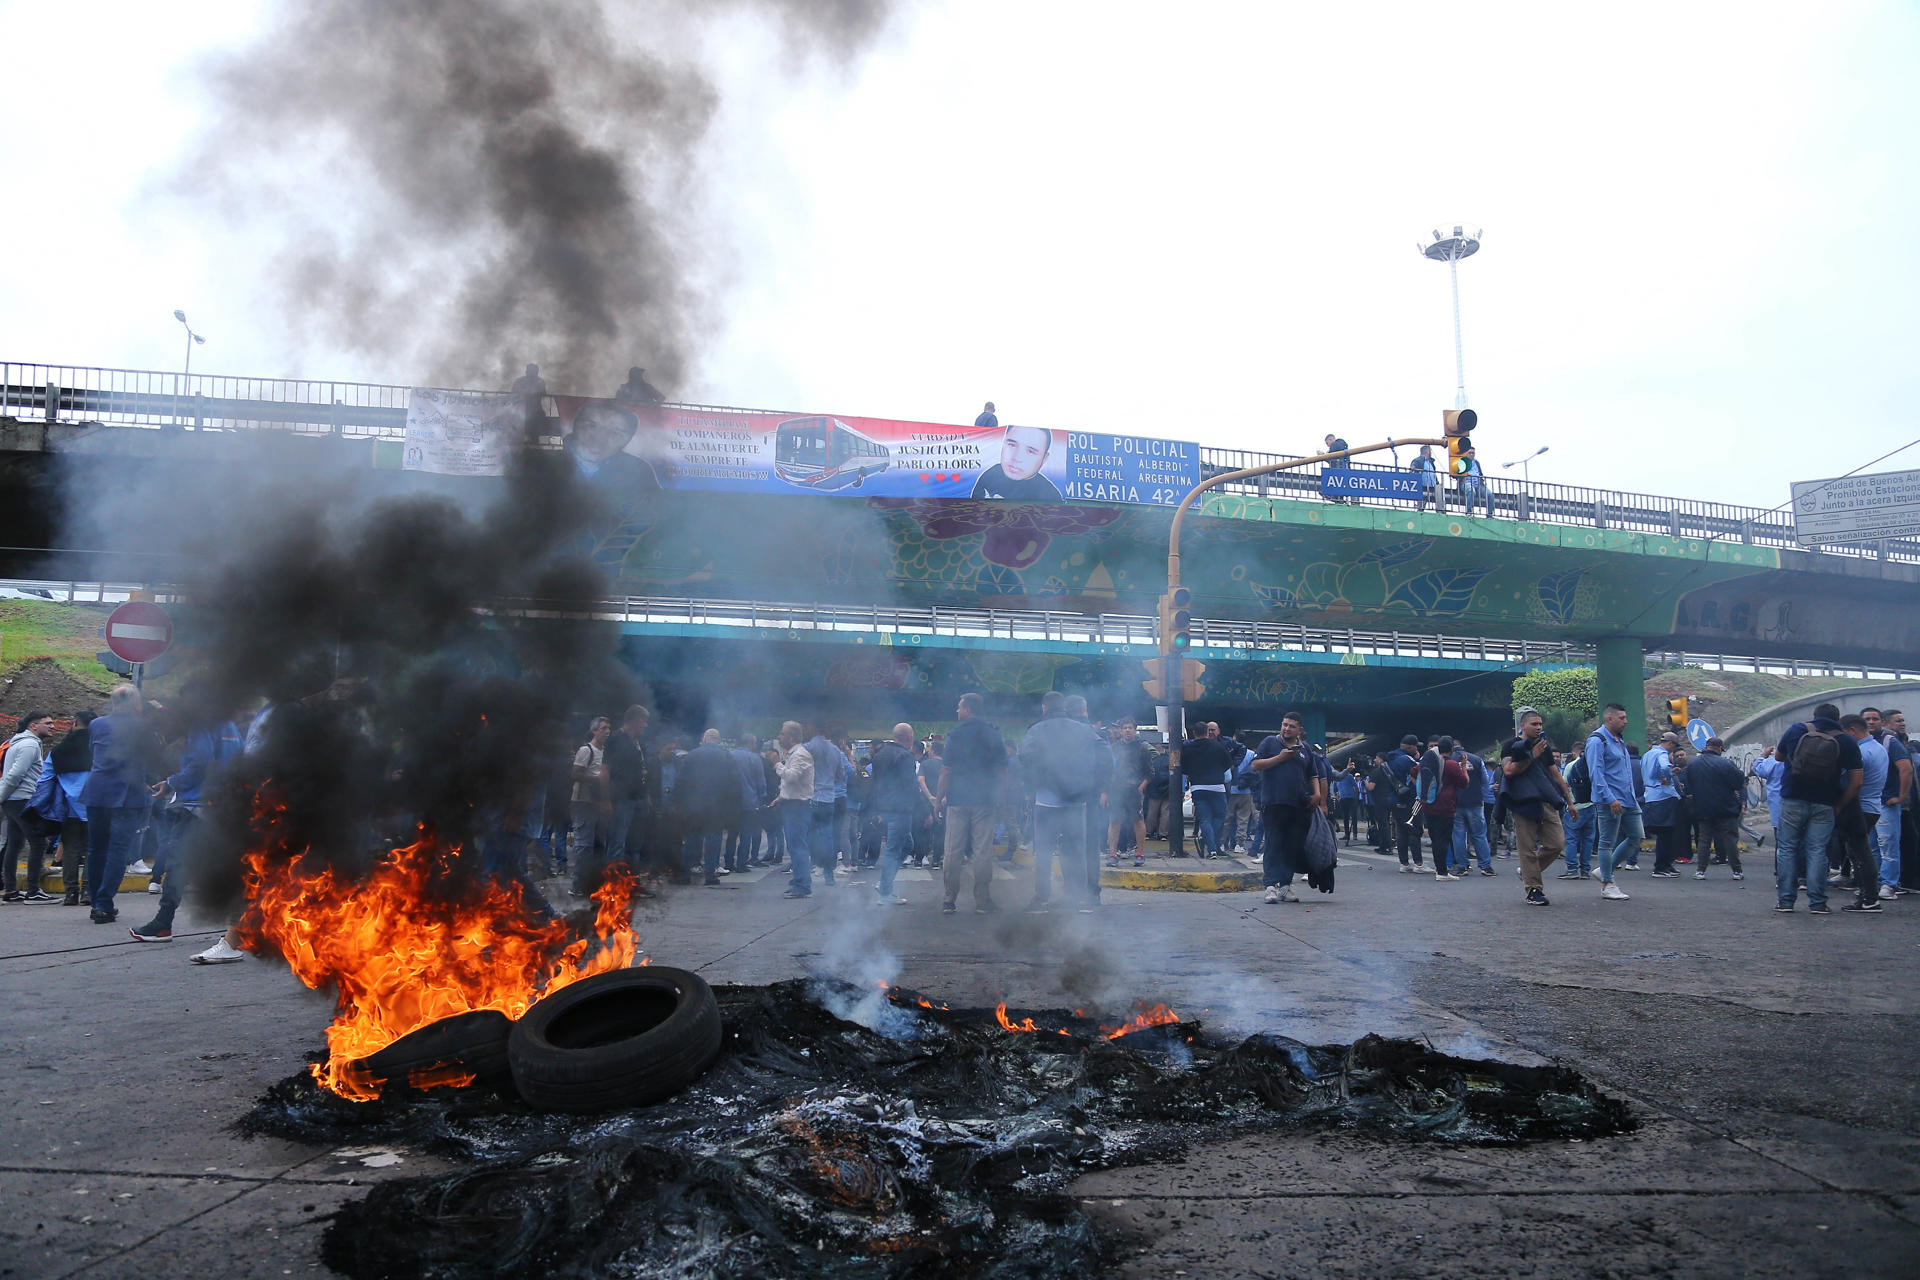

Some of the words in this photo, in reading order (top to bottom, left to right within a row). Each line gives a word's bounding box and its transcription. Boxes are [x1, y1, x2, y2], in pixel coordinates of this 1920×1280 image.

[911, 433, 958, 441] VERDAD
[670, 440, 686, 450] DE
[688, 441, 760, 454] ALMAFUERTE
[898, 445, 949, 455] JUSTICIA
[951, 445, 980, 455] PARA
[1068, 433, 1098, 451] ROL
[1113, 436, 1188, 458] POLICIAL
[684, 455, 732, 466] SIEMPRE
[734, 457, 749, 466] TE
[897, 460, 935, 469] PABLO
[939, 459, 982, 469] FLORES
[1073, 453, 1124, 467] BAUTISTA
[1138, 458, 1183, 472] ALBERDI
[1077, 467, 1124, 481] FEDERAL
[1138, 472, 1193, 487] ARGENTINA
[1327, 475, 1346, 488] AV.
[1348, 476, 1388, 491] GRAL.
[1392, 479, 1418, 492] PAZ
[1823, 480, 1854, 491] Ciudad
[1856, 478, 1867, 488] de
[1869, 477, 1904, 487] Buenos
[1065, 481, 1140, 502] MISARIA
[1827, 487, 1873, 500] Prohibido
[1821, 500, 1846, 510] Junto
[1856, 498, 1865, 506] la
[1866, 496, 1891, 505] acera
[1811, 534, 1835, 542] Salvo
